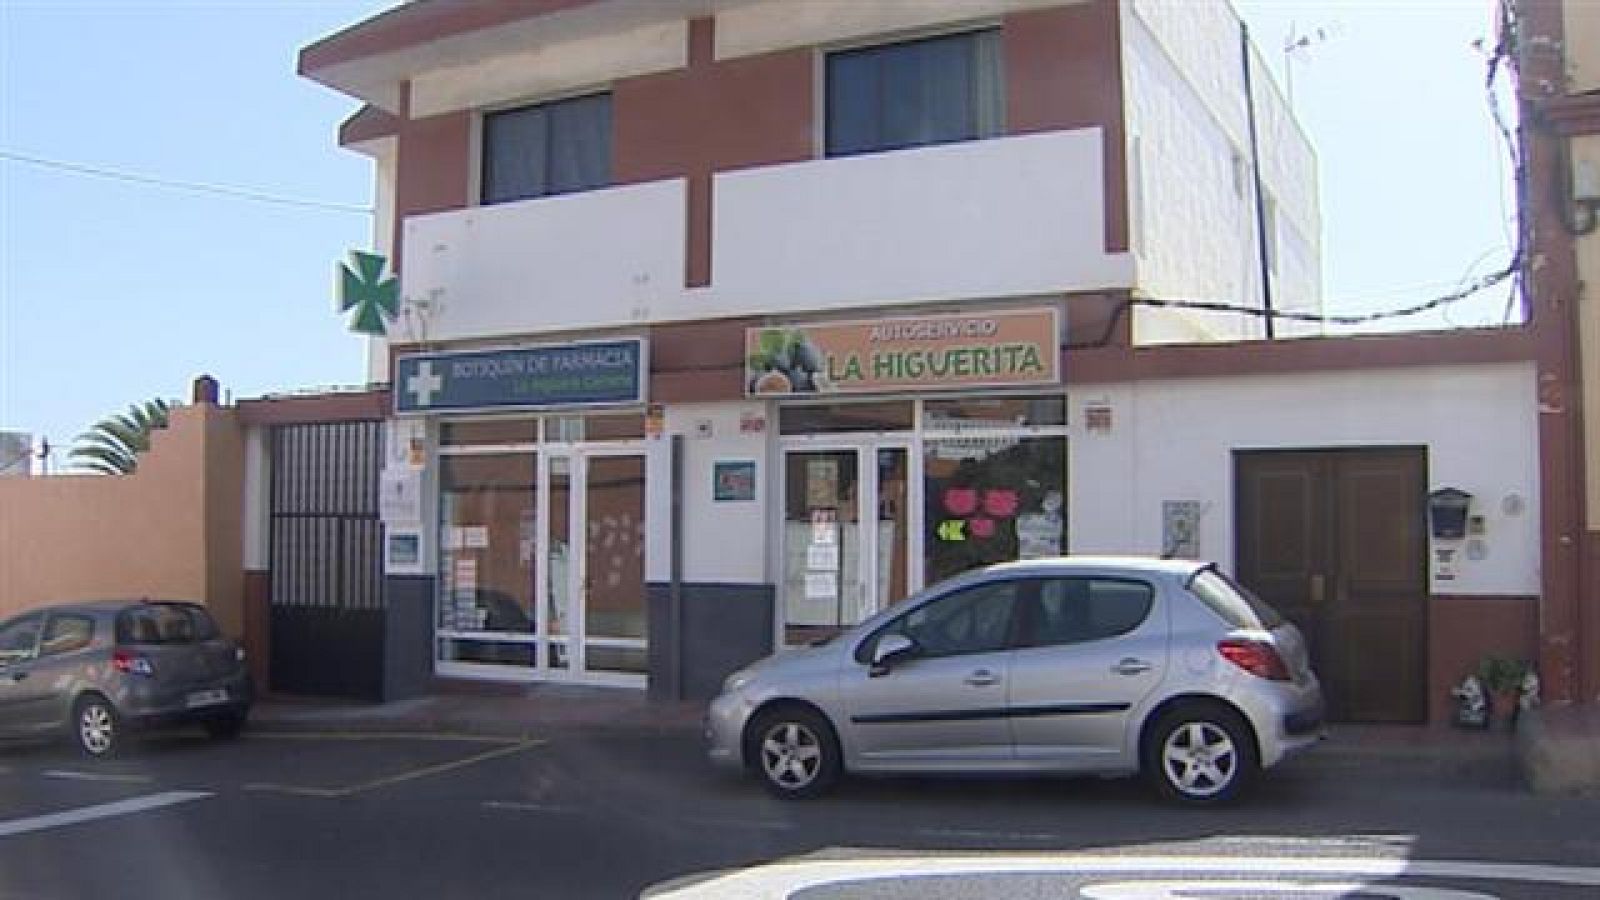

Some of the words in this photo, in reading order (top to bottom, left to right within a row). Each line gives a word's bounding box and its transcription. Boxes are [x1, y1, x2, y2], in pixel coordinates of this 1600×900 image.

[526, 355, 549, 374] DE
[826, 352, 865, 382] LA
[872, 345, 1043, 380] HIGUERITA
